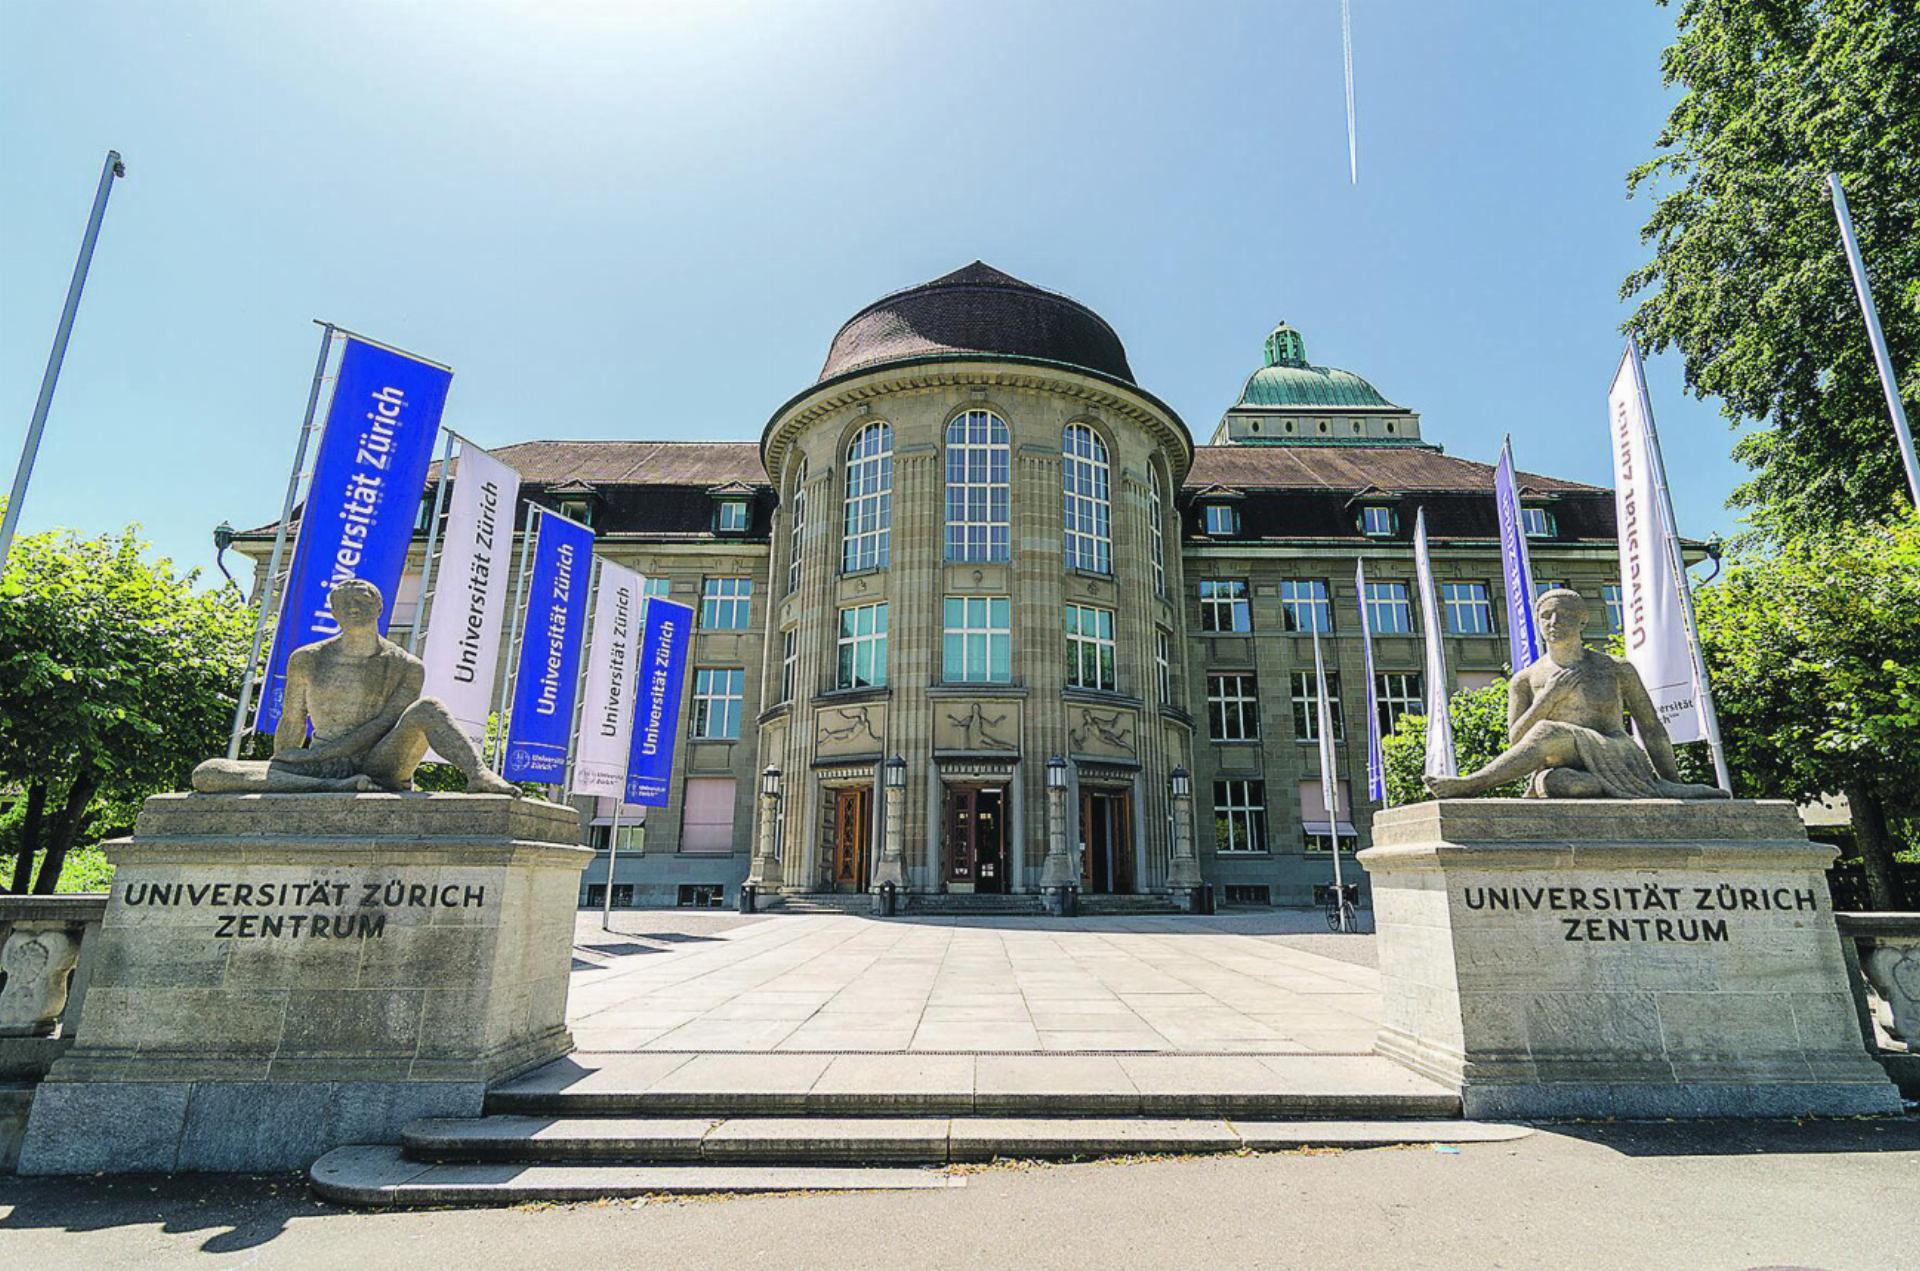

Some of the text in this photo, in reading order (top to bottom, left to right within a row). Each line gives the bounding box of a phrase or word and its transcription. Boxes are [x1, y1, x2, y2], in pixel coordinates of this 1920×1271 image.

[356, 385, 405, 471] Zürich
[454, 481, 498, 683] Universität Zürich
[536, 543, 574, 716] Universität Zürich
[600, 586, 629, 738] Universität Zürich
[641, 620, 675, 756] Universität Zürich
[125, 879, 485, 908] UNIVERSITÄT ZÜRICH
[214, 914, 386, 939] ZENTRUM
[1465, 883, 1818, 911] UNIVERSITÄT ZÜRICH
[1562, 918, 1729, 942] ZENTRUM
